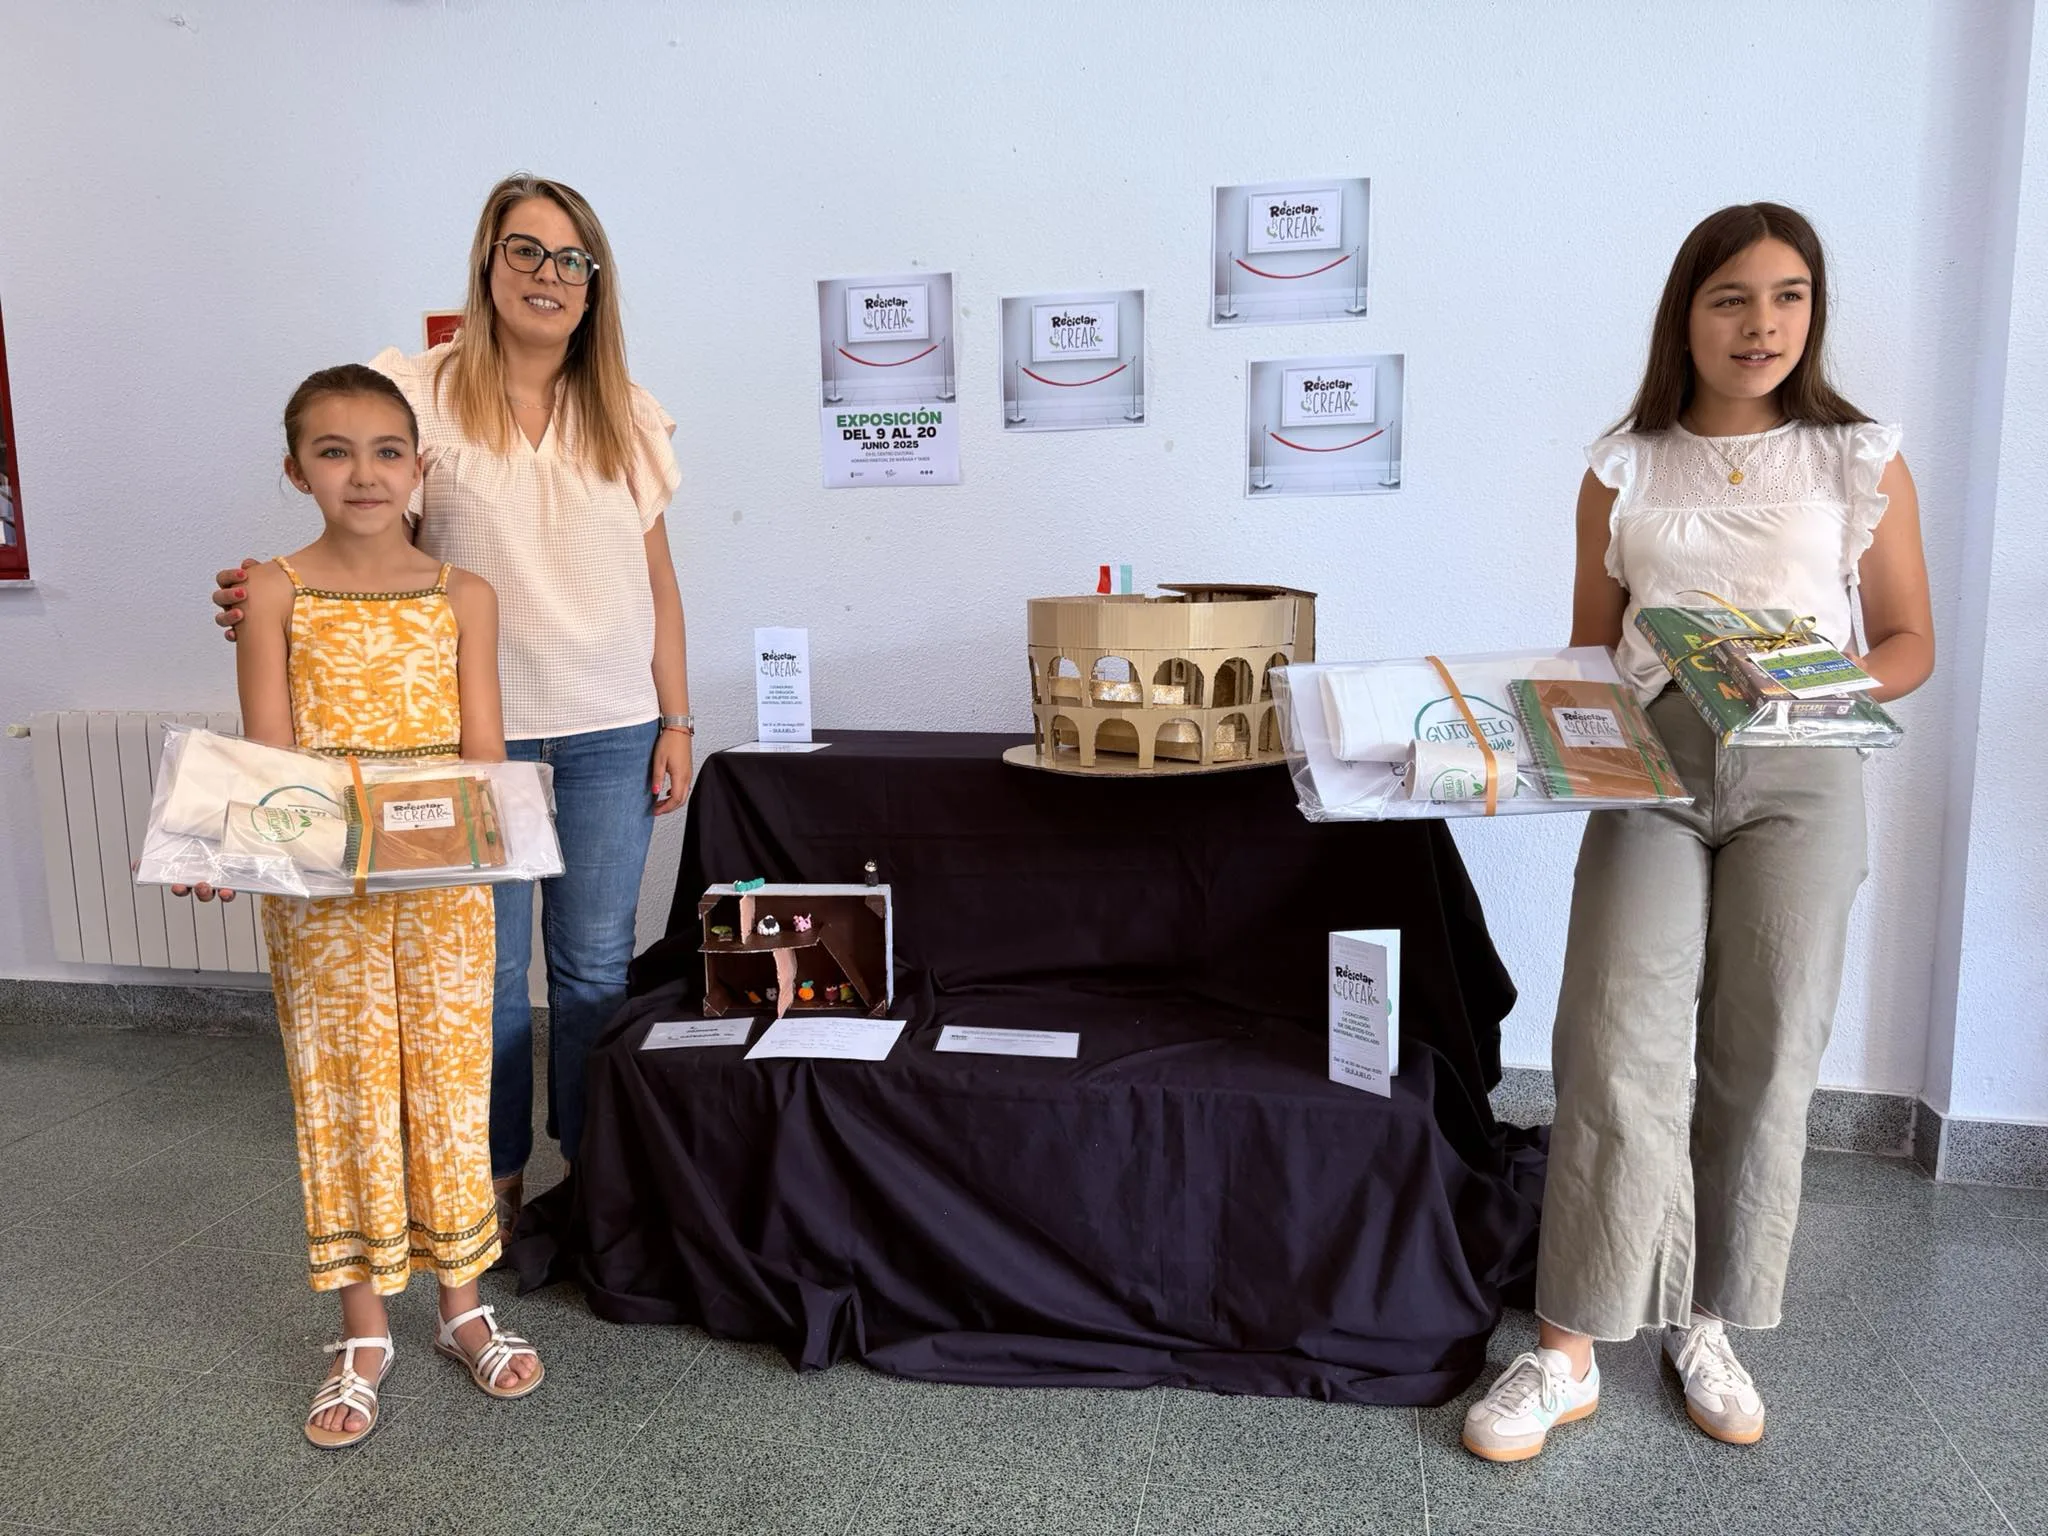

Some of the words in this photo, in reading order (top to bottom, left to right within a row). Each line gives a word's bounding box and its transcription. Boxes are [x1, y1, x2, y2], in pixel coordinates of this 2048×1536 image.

[1269, 204, 1319, 218] Reciclar
[1279, 215, 1317, 240] CREAR
[864, 297, 908, 310] Reciclar
[874, 308, 908, 330] CREAR
[1051, 315, 1097, 328] Reciclar
[1060, 327, 1096, 349] CREAR
[1303, 379, 1353, 392] Reciclar
[1313, 390, 1351, 414] CREAR
[836, 406, 942, 428] EXPOSICIÓN
[843, 428, 871, 440] DEL
[876, 428, 886, 440] 9
[891, 427, 912, 439] AL
[917, 426, 937, 438] 20
[861, 441, 890, 450] JUNIO
[893, 440, 919, 449] 2025
[762, 653, 797, 661] Reciclar
[769, 661, 797, 677] CREAR
[1562, 712, 1608, 721] Reciclar
[1575, 720, 1610, 735] CREAR
[393, 803, 444, 811] Reciclar
[404, 808, 444, 821] CREAR
[1335, 966, 1374, 985] Reciclar
[1343, 980, 1374, 1006] CREAR
